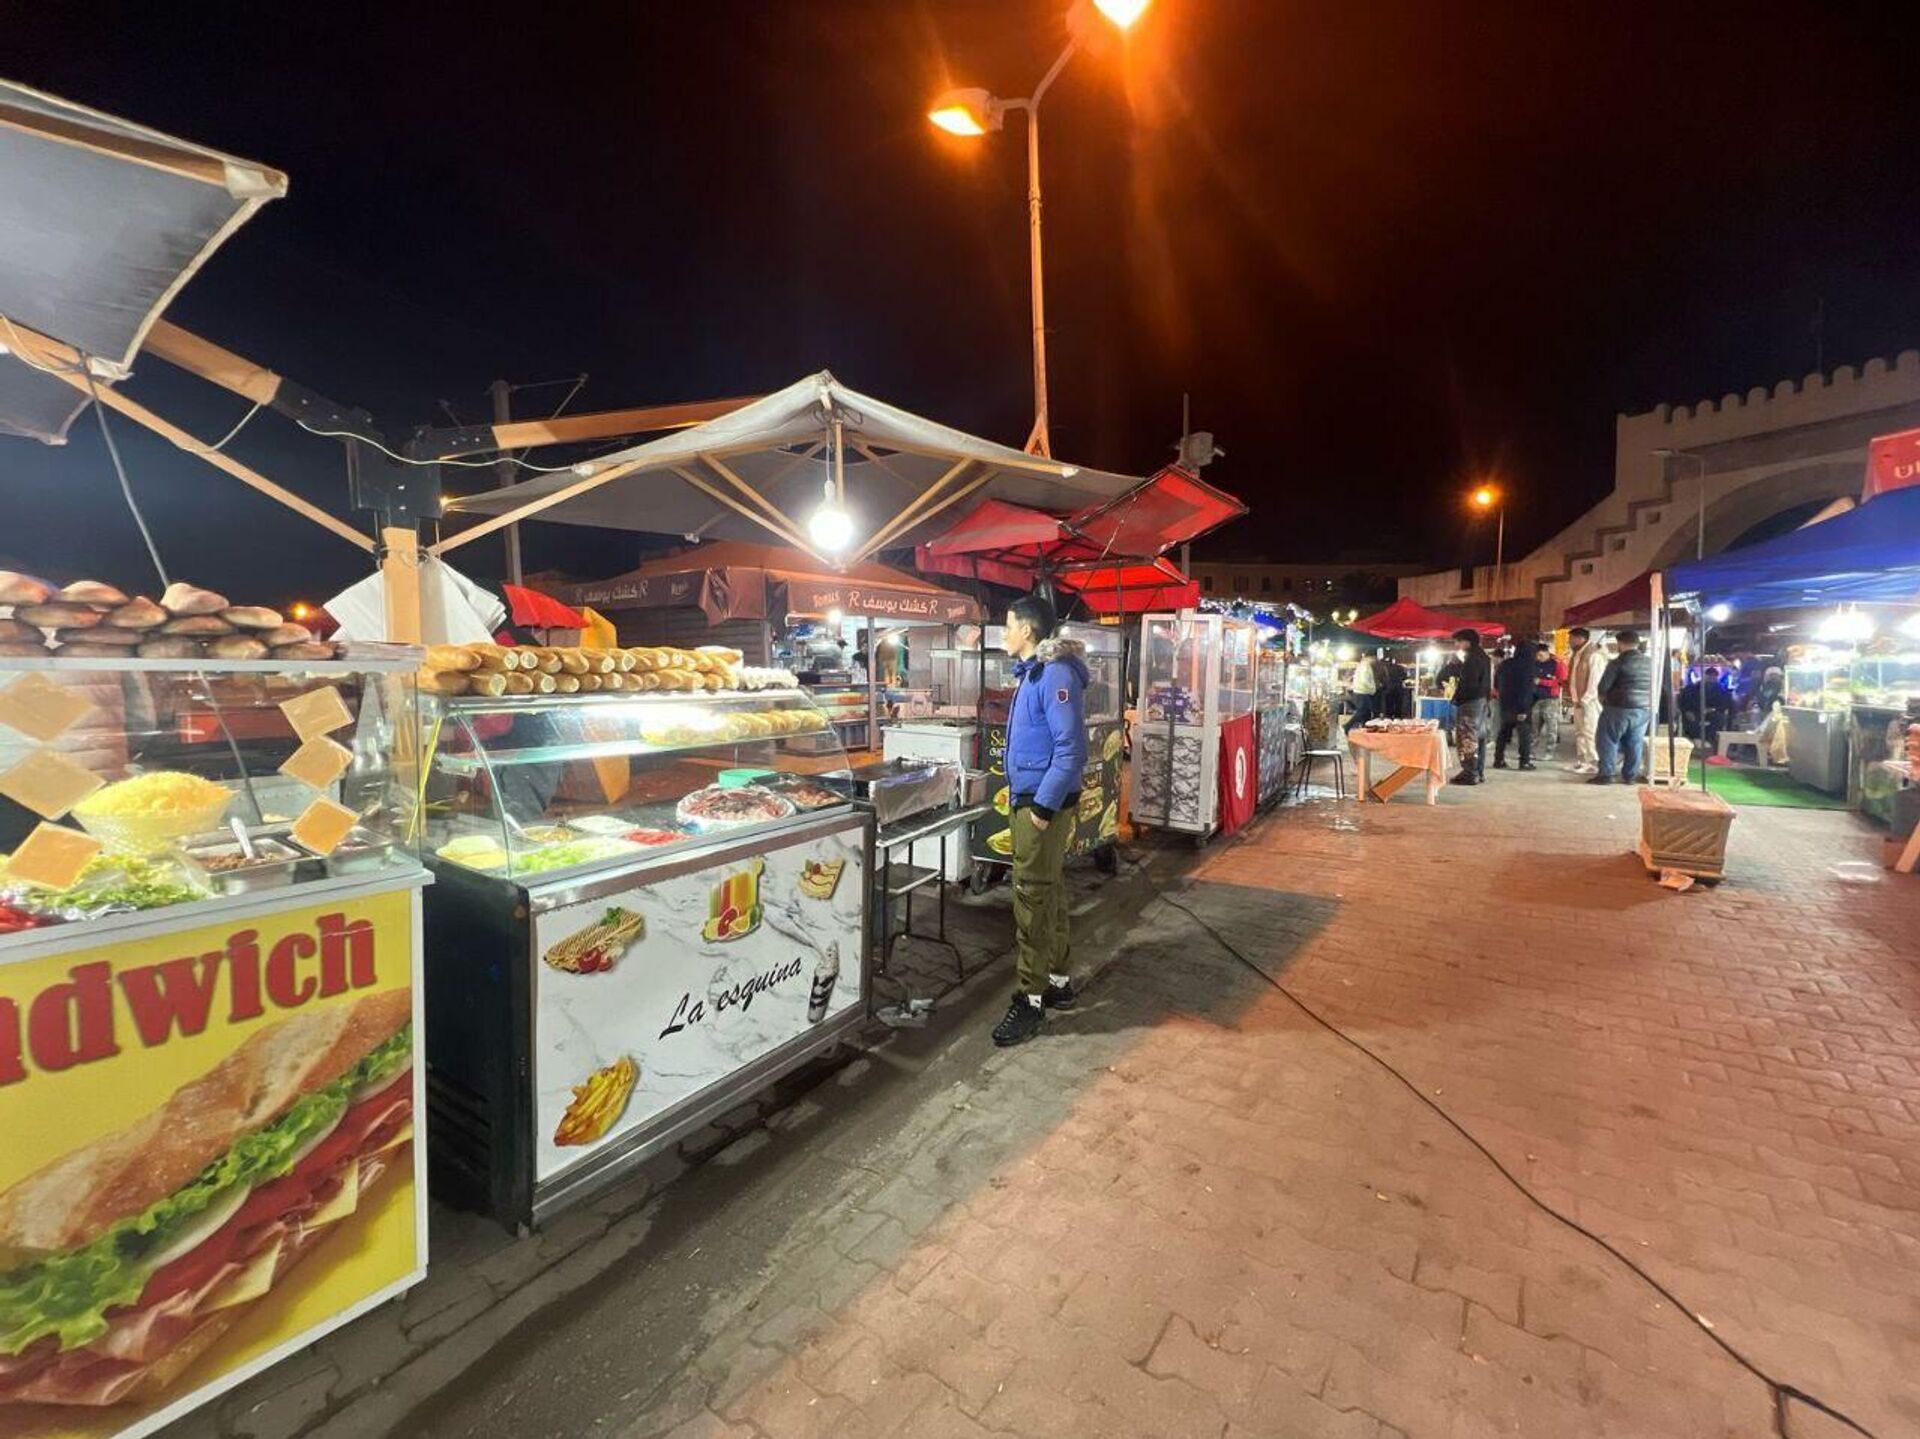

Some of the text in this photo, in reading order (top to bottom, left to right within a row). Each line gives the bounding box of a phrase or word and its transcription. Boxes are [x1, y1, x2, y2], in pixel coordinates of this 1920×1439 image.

[862, 598, 898, 614] يوسف
[899, 600, 928, 614] كشك
[658, 956, 802, 1040] La esquina
